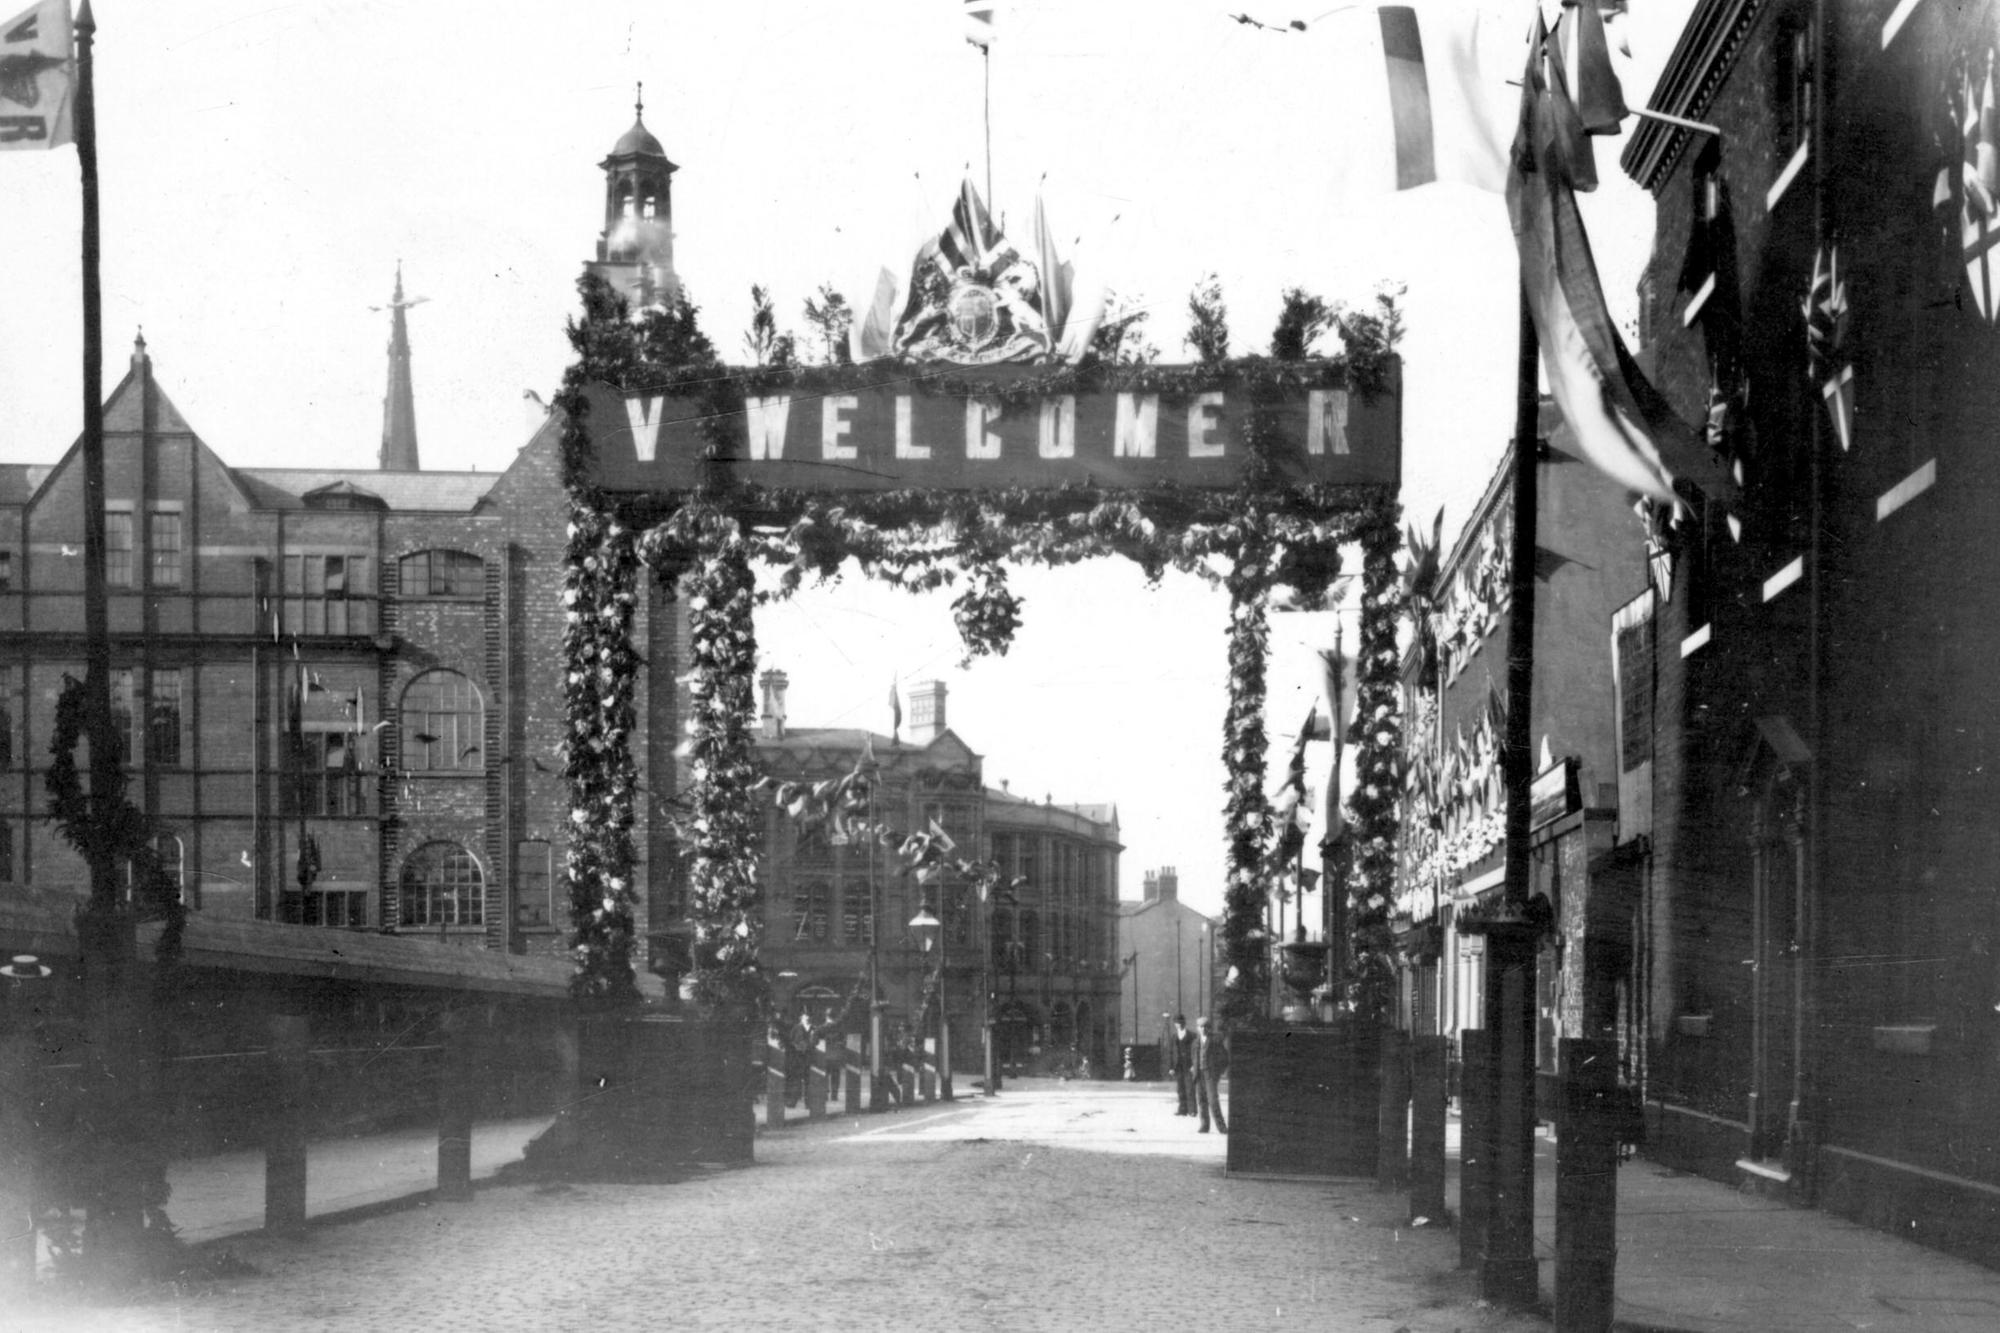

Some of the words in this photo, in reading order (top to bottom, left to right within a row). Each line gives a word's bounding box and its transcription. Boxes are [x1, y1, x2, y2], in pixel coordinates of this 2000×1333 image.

[625, 395, 664, 461] V
[746, 391, 1225, 461] WELCOME
[1307, 389, 1350, 455] R
